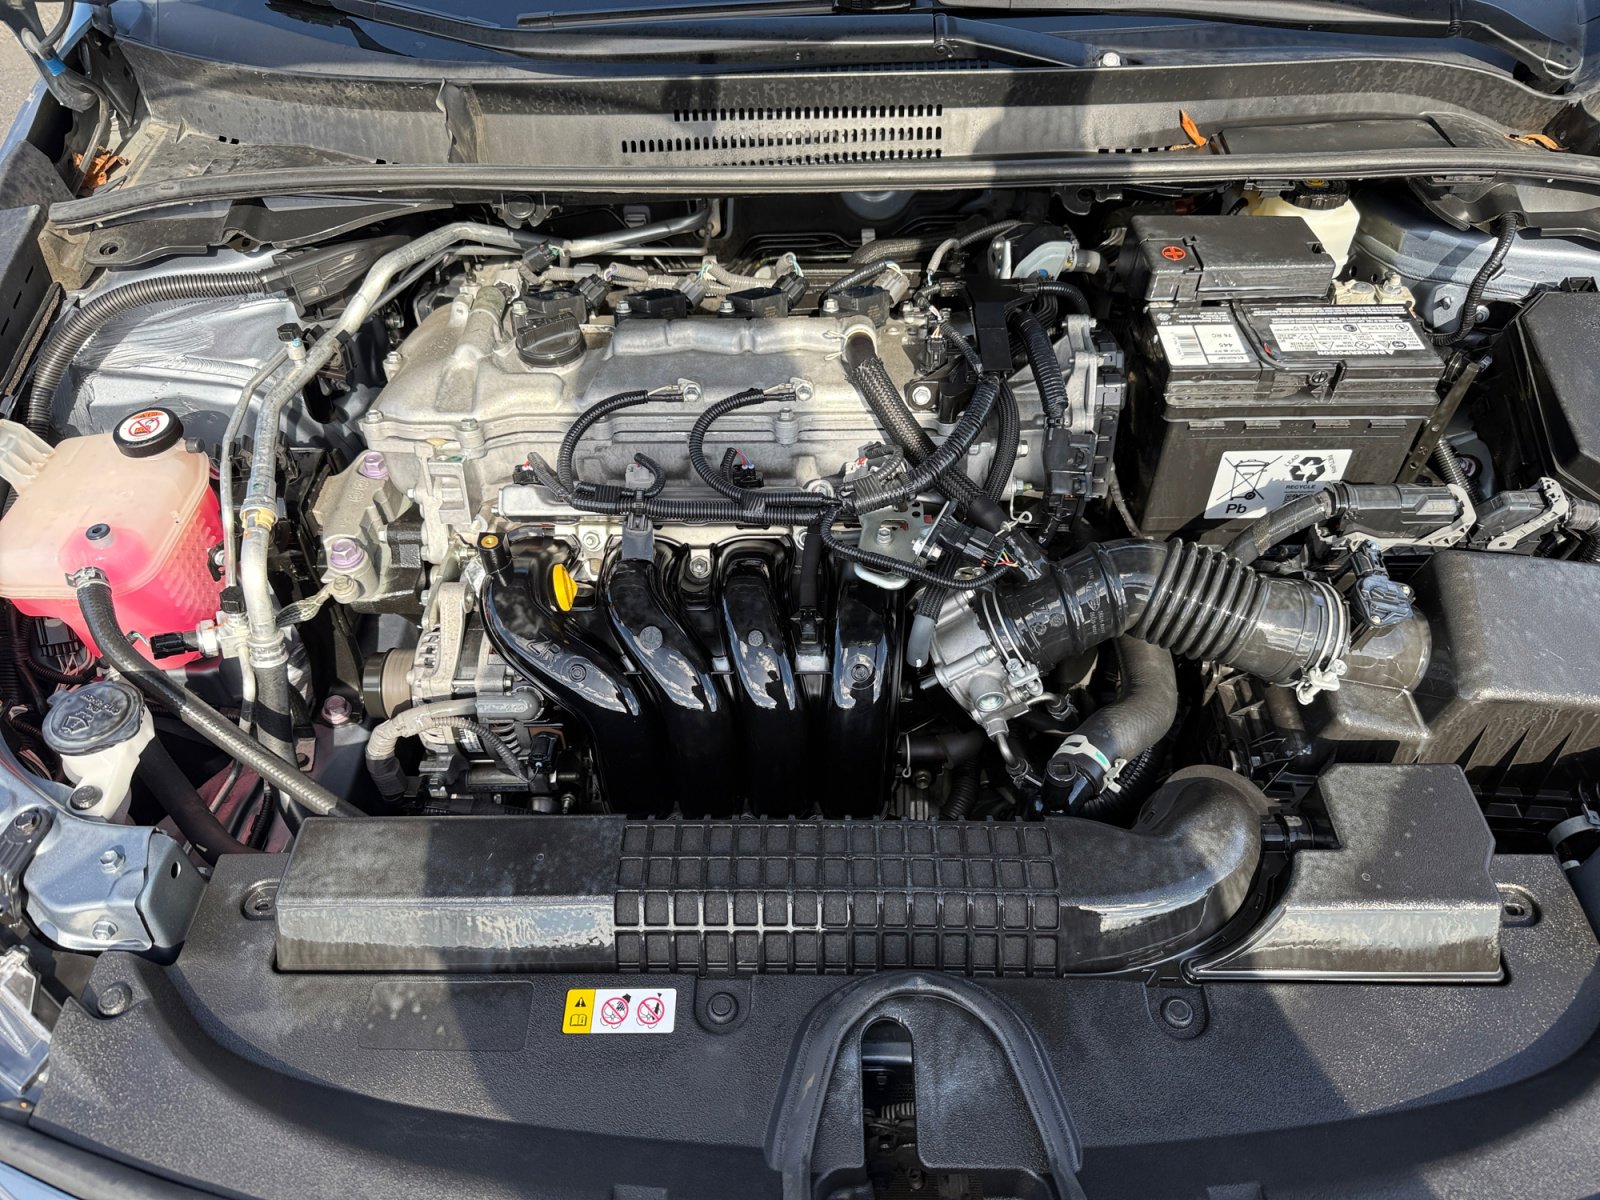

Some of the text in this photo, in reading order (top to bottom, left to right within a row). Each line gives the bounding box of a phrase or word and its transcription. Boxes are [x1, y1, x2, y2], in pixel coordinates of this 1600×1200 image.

[1284, 454, 1300, 467] LEAD
[1327, 454, 1337, 474] RETURN
[1225, 503, 1247, 514] Pb
